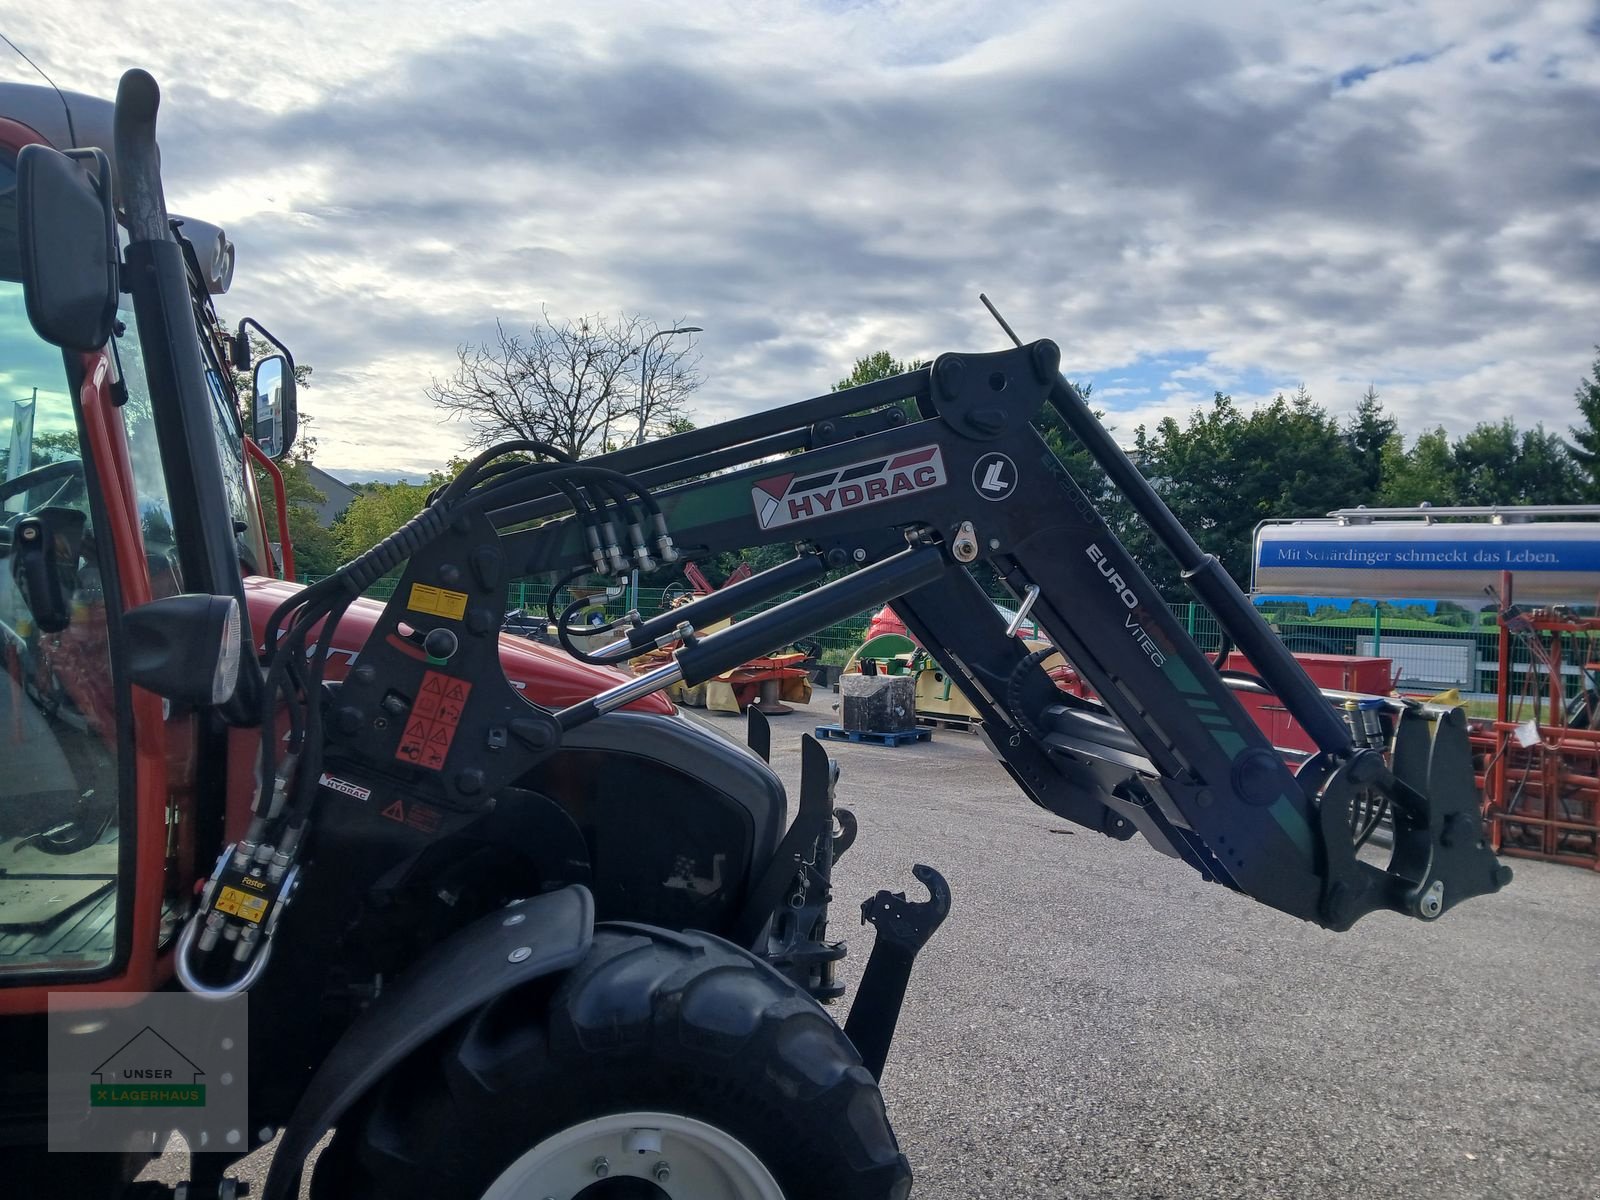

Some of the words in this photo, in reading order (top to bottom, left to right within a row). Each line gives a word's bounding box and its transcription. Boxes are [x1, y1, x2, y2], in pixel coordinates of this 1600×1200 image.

[788, 466, 937, 520] HYDRAC
[1278, 549, 1301, 561] Mit
[1394, 549, 1469, 563] schmeckt
[1473, 550, 1501, 563] das
[1505, 550, 1560, 564] Leben.
[1085, 543, 1139, 609] EURO
[1124, 613, 1167, 668] VITEC
[327, 780, 367, 799] HYDRAC
[241, 876, 267, 889] Faster
